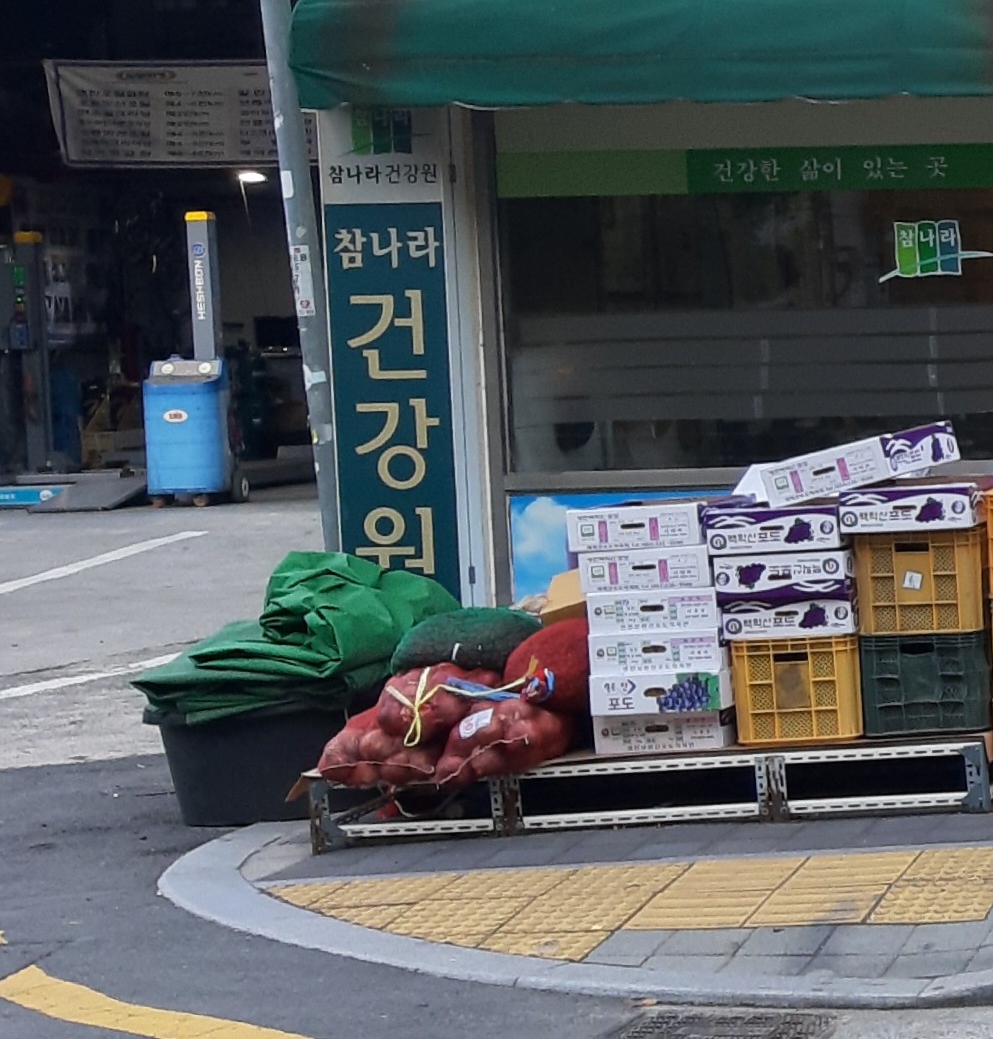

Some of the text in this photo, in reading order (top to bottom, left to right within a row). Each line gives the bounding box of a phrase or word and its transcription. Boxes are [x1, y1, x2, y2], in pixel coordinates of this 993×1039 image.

[713, 156, 949, 183] 건강한 삶이 있는 곳
[334, 226, 440, 270] 참나라
[899, 228, 958, 248] 참나라
[193, 259, 207, 320] HESHBON
[608, 696, 635, 711] 포도
